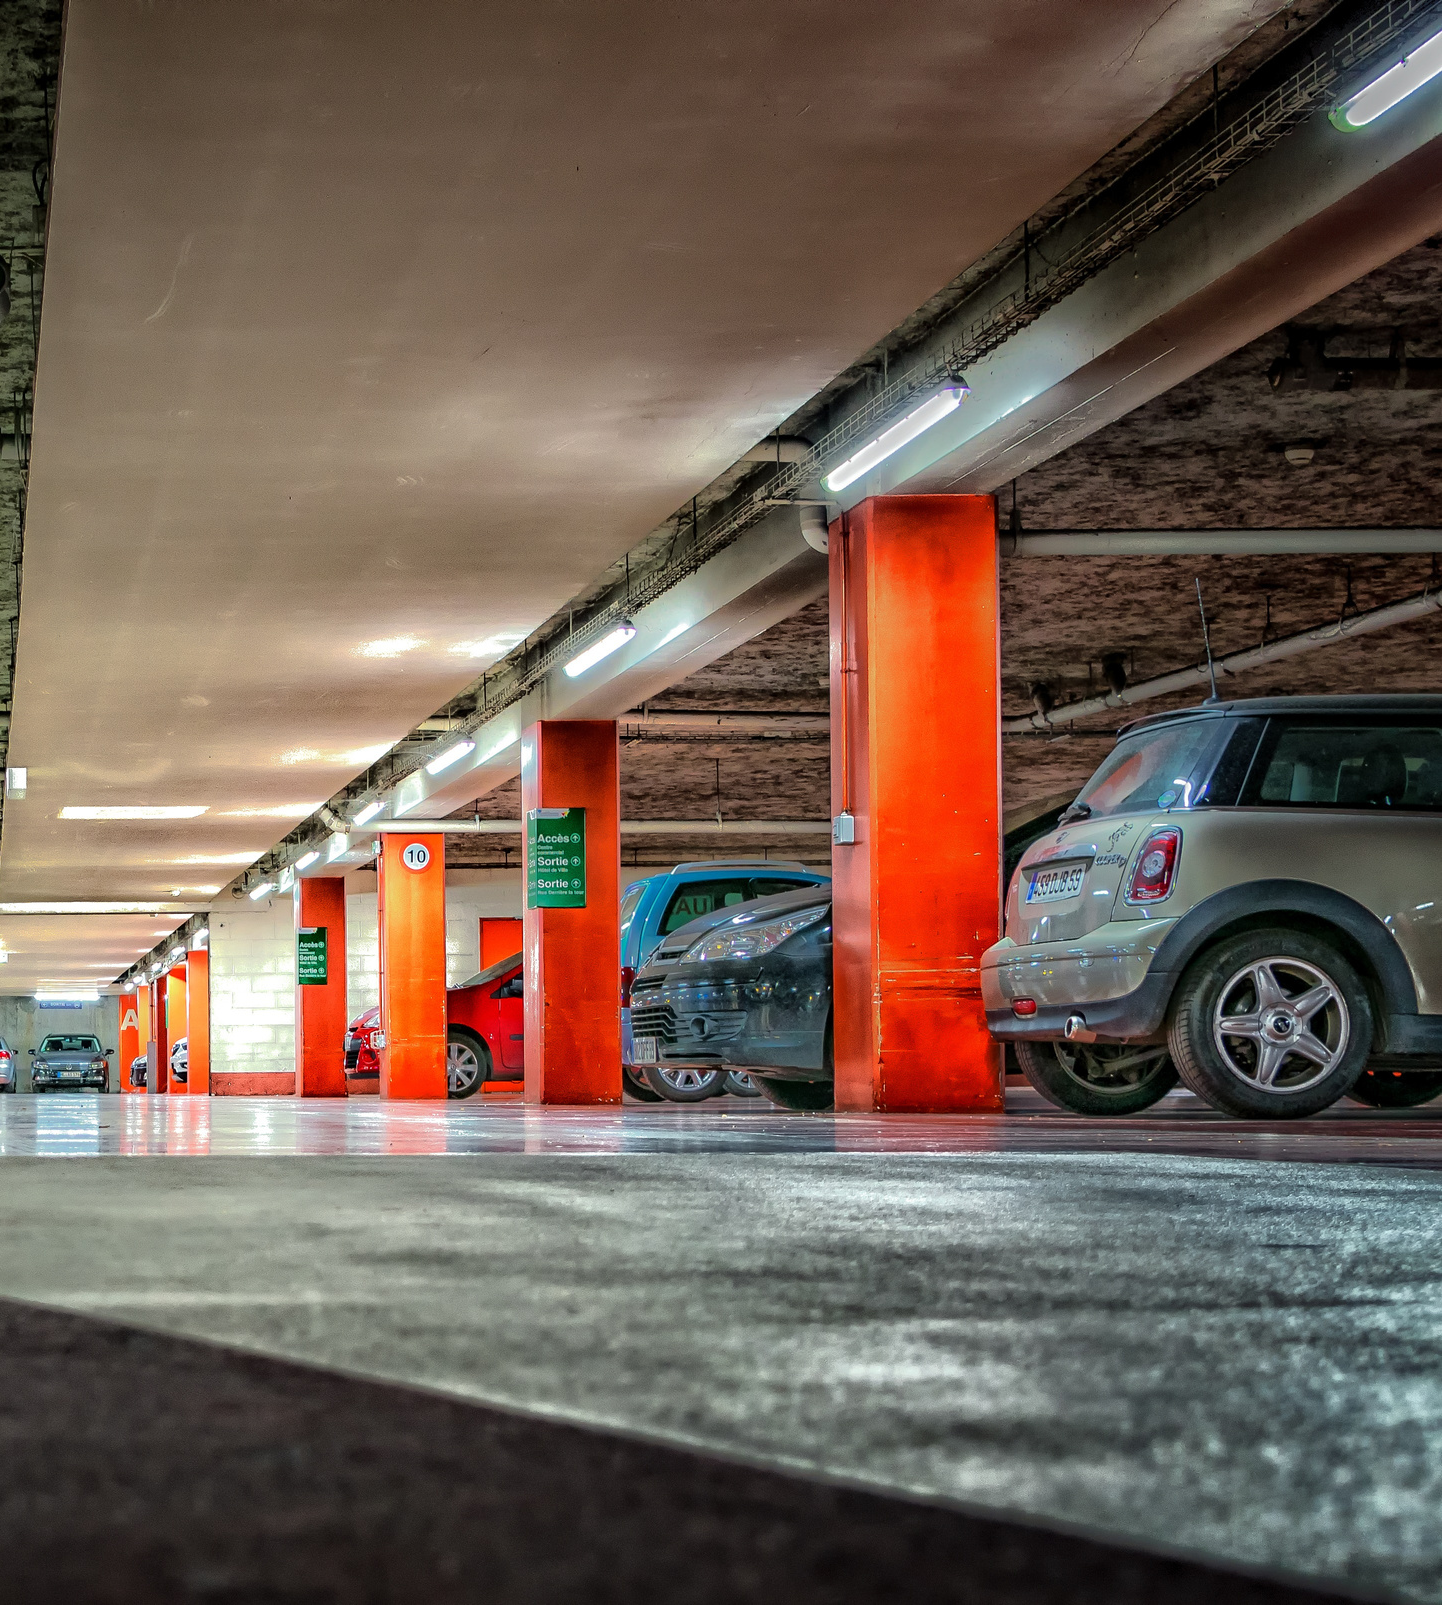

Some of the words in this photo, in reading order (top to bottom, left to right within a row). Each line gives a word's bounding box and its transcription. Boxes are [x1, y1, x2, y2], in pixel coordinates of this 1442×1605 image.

[537, 833, 570, 843] Accès
[407, 849, 426, 863] 10
[537, 857, 569, 866] Sortie
[537, 879, 569, 888] Sortie
[1033, 873, 1052, 897] 459
[1048, 870, 1070, 895] DJB
[1067, 868, 1083, 892] 59
[120, 1008, 138, 1031] A
